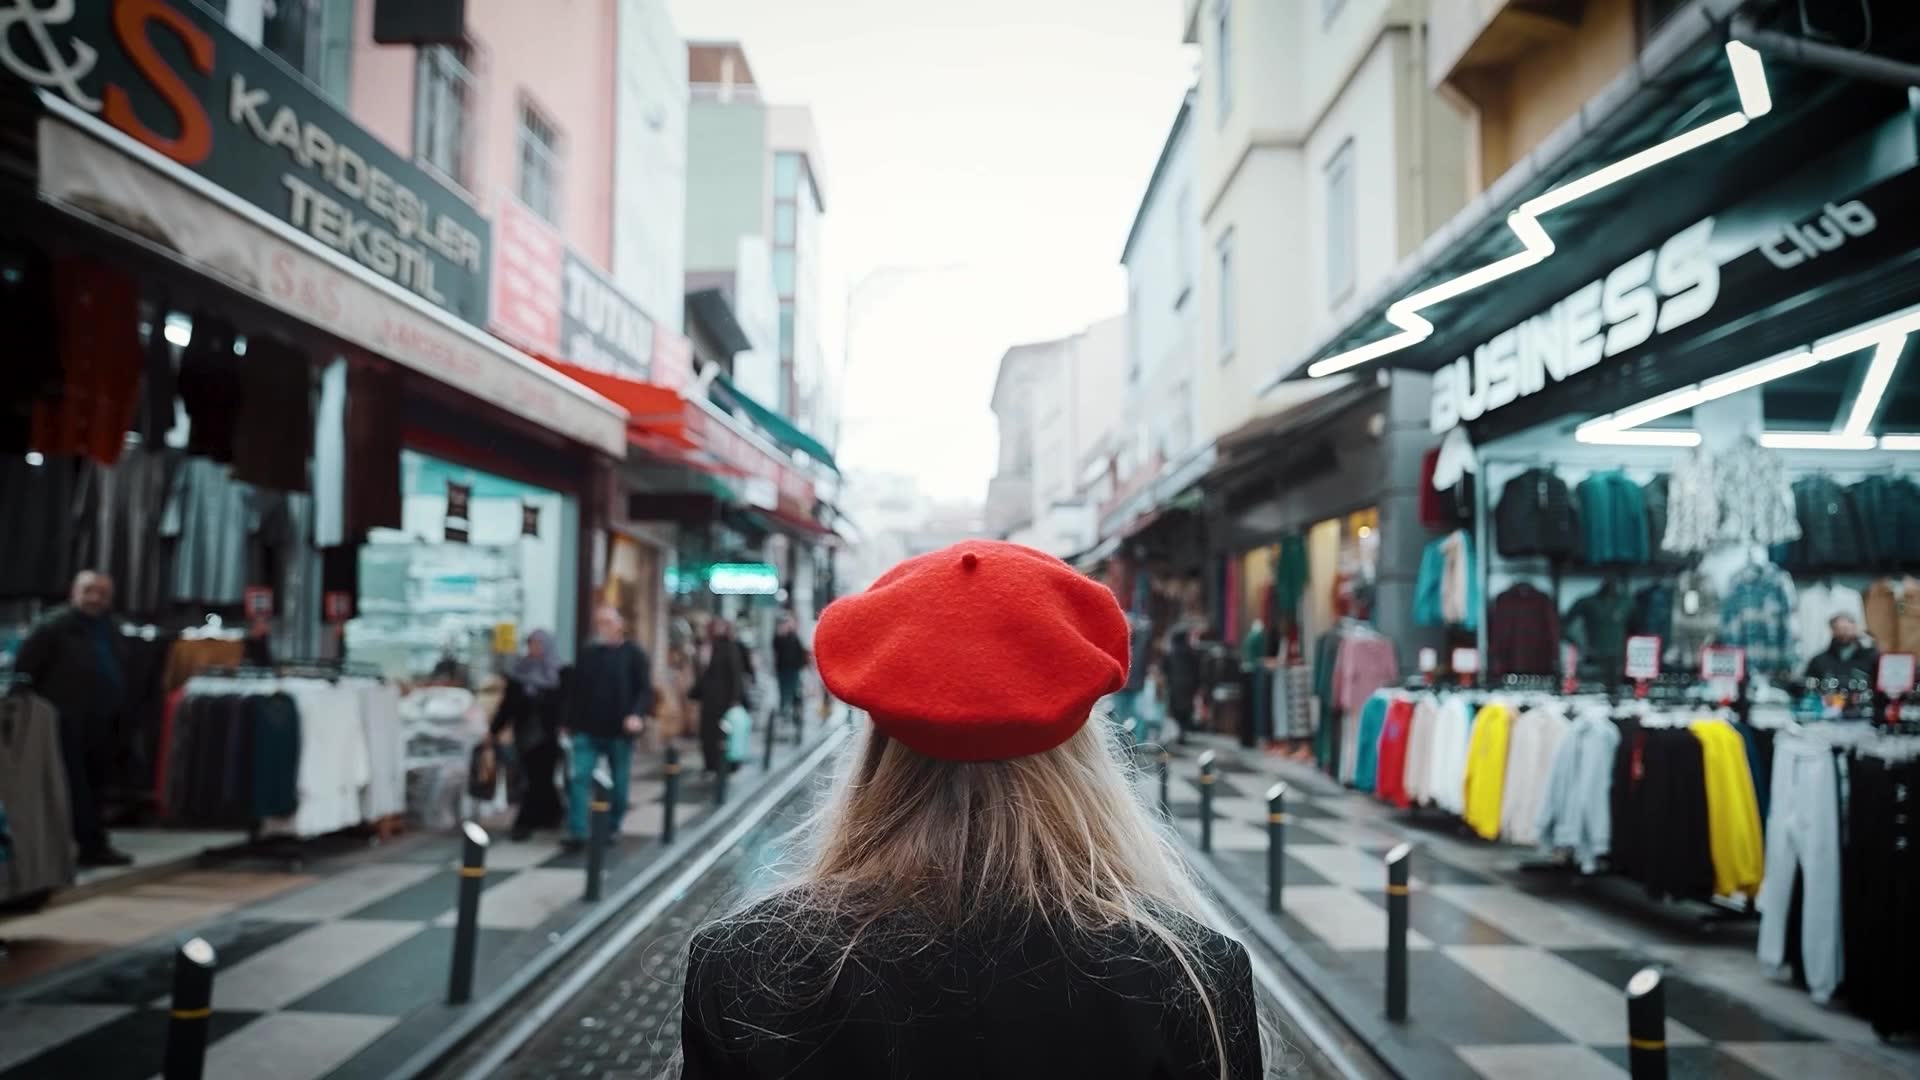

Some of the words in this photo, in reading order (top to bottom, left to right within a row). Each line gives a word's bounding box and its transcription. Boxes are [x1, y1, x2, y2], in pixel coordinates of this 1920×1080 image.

[229, 72, 482, 274] KARDEŞLER
[280, 173, 447, 304] TEKSTİL
[1429, 215, 1720, 435] BUSINESS
